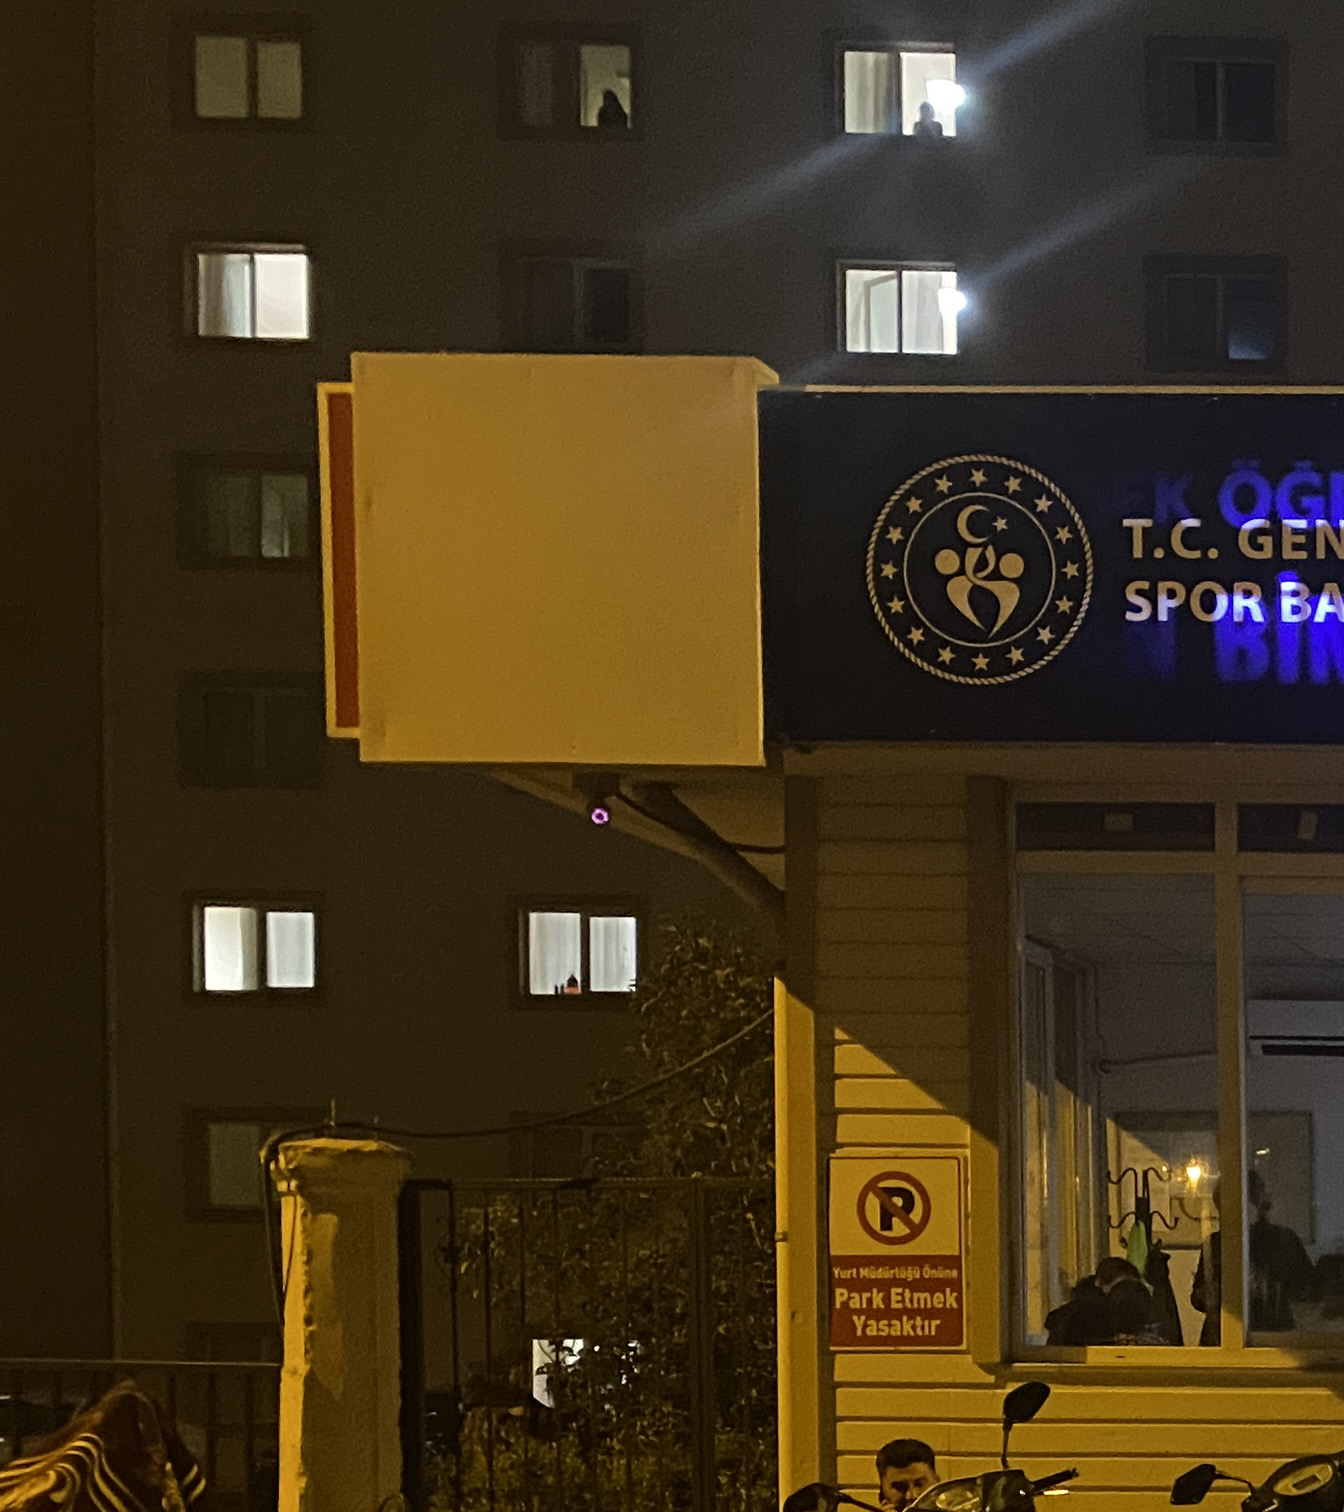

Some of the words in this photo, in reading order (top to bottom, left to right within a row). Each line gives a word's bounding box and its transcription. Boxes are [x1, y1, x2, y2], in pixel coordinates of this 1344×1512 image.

[1121, 518, 1220, 561] T.C.
[1123, 579, 1265, 623] SPOR
[832, 1265, 857, 1279] Yurt
[859, 1262, 920, 1281] Müdürlüğü
[922, 1263, 958, 1279] Önüne
[834, 1287, 885, 1309] Park
[890, 1287, 959, 1309] Etmek
[852, 1314, 941, 1336] Yasaktır
